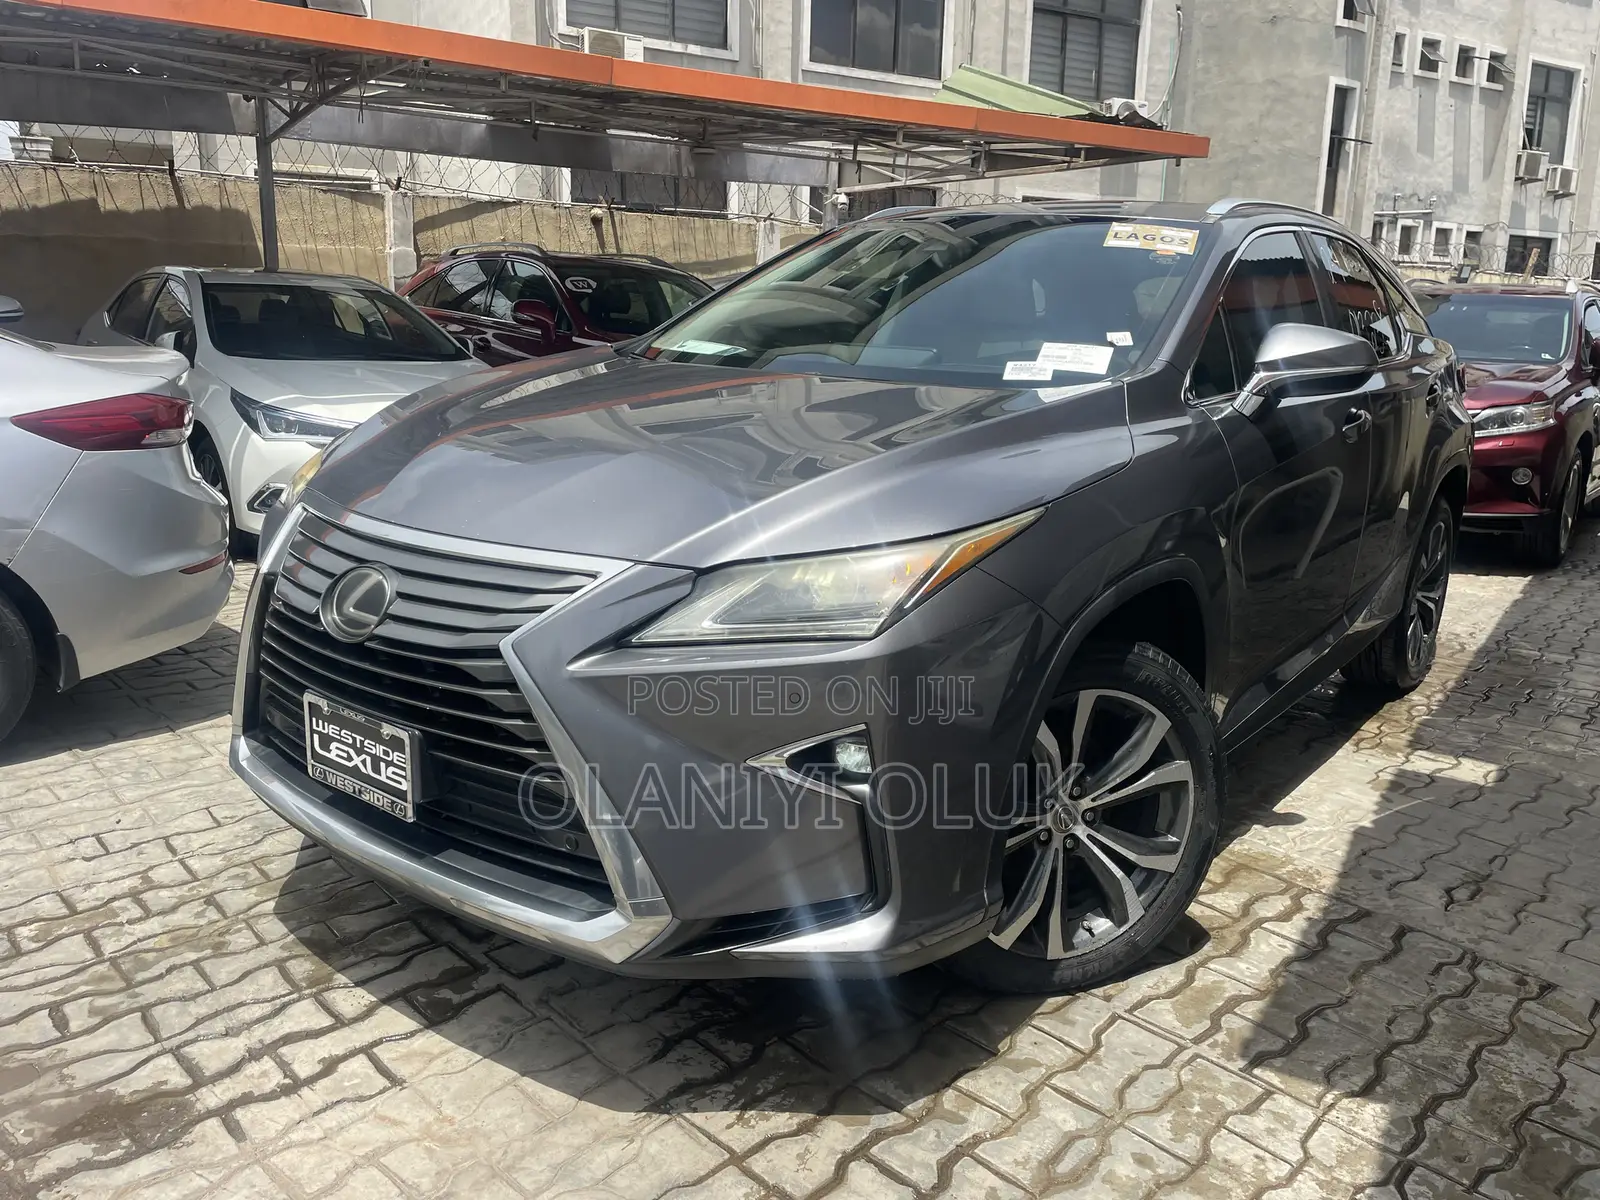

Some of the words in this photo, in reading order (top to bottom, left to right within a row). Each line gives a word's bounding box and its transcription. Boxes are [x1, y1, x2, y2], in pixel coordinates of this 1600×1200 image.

[1113, 231, 1189, 245] LAGOS
[312, 717, 407, 767] WESTSIDE
[313, 733, 408, 791] LEXUS
[325, 771, 392, 811] WESTSIDE
